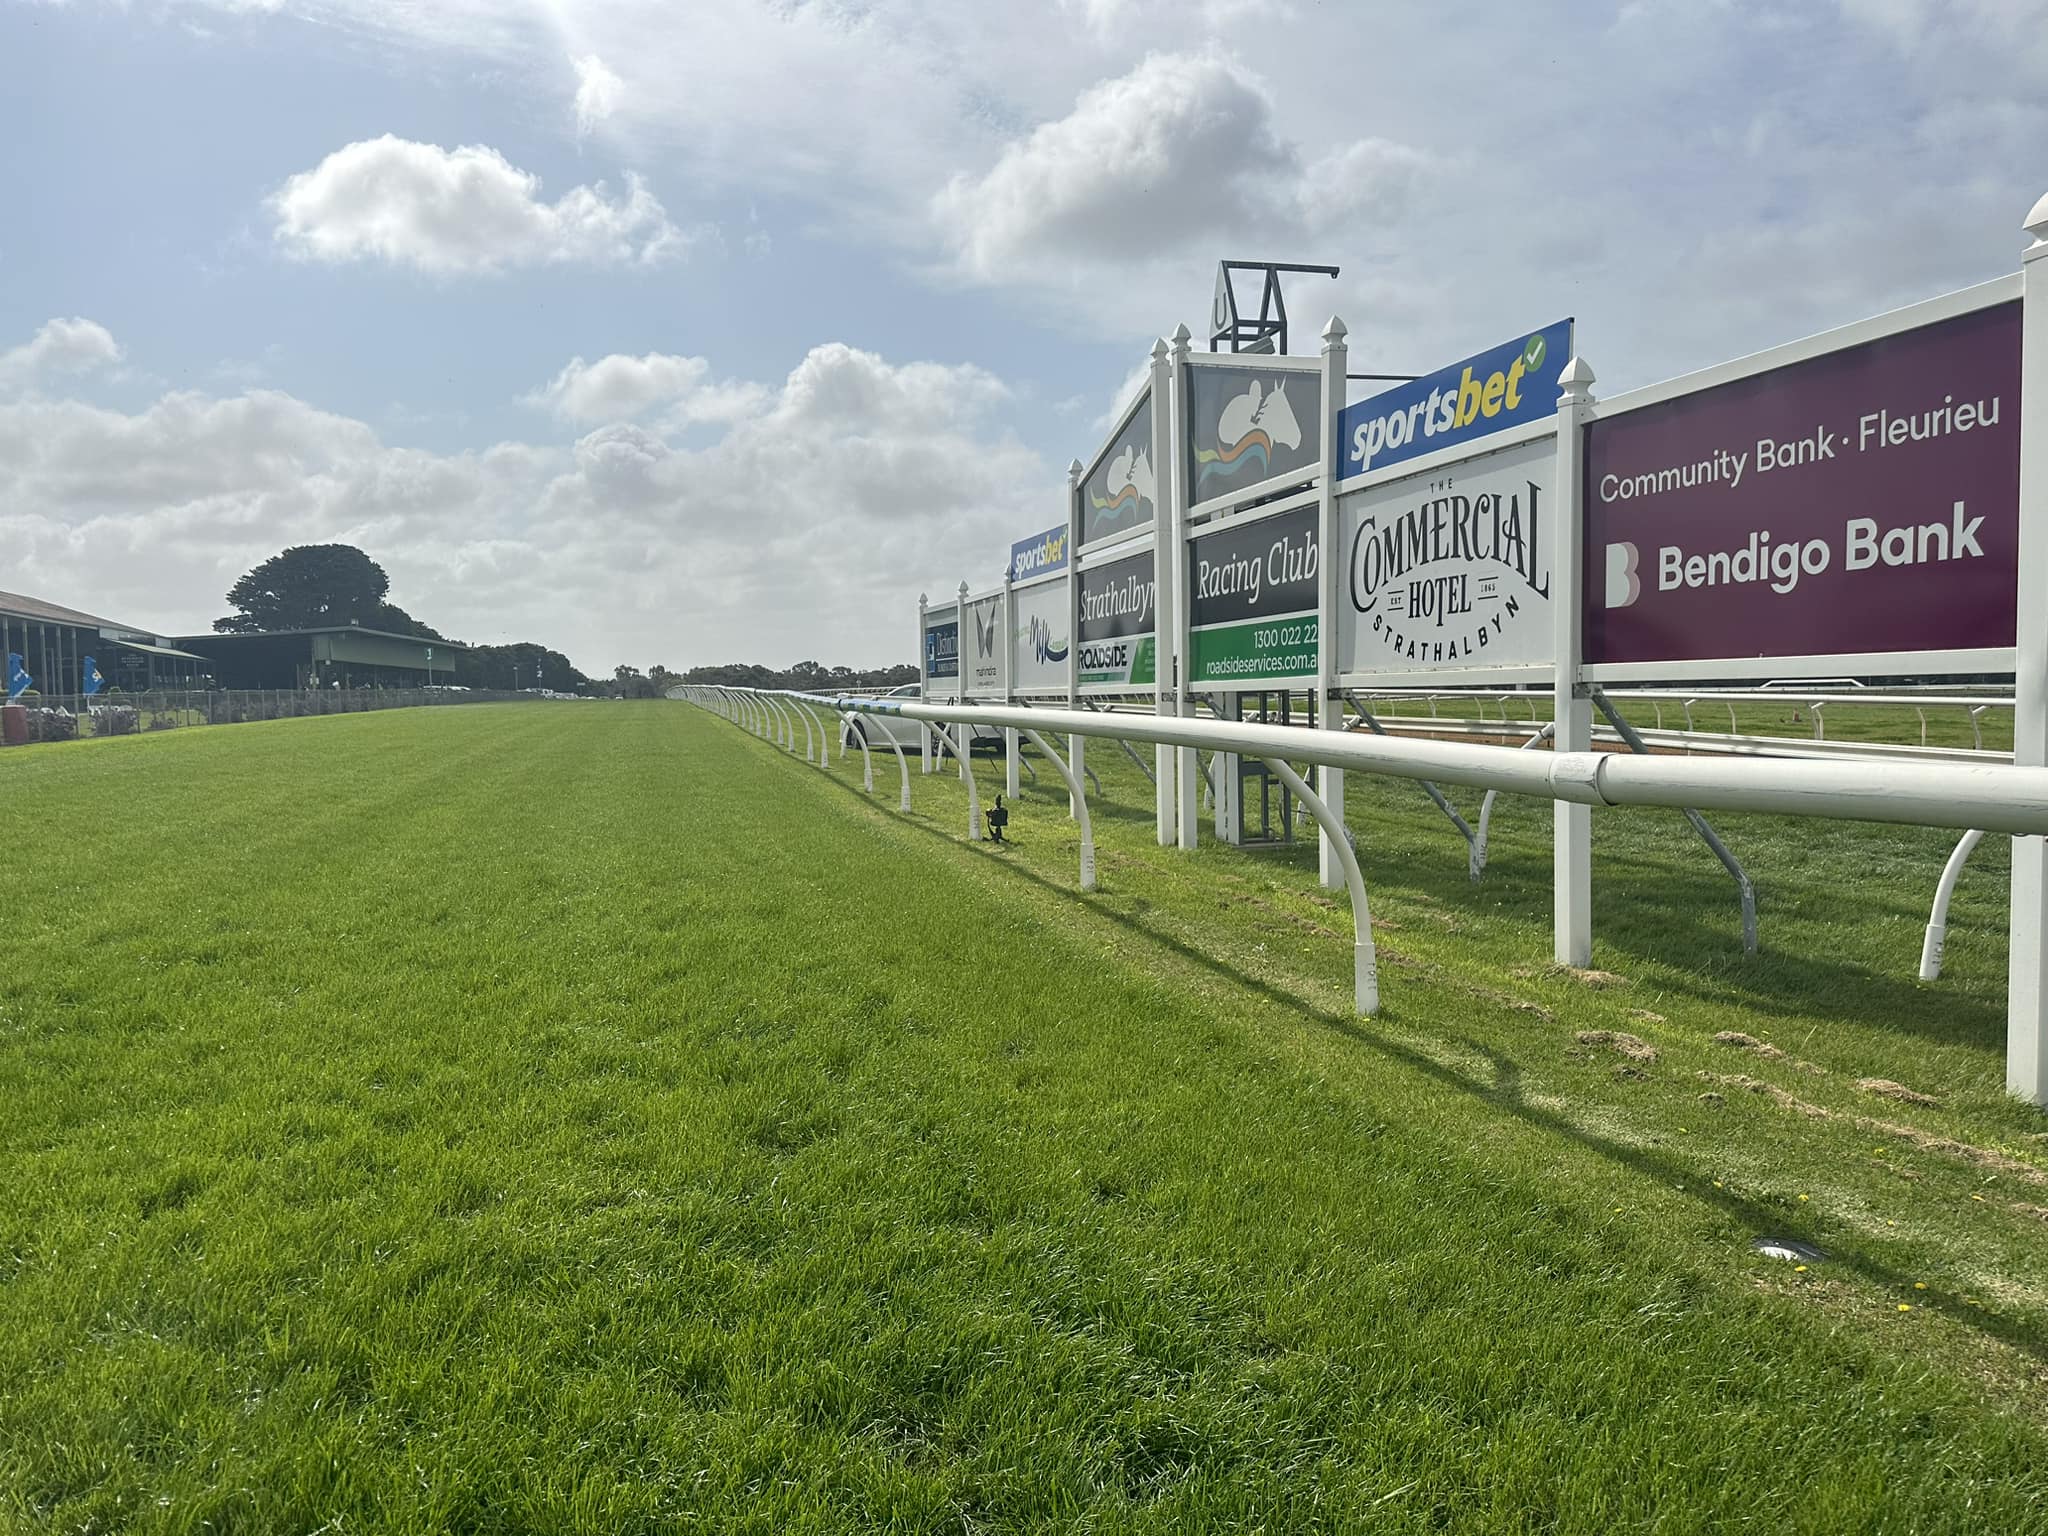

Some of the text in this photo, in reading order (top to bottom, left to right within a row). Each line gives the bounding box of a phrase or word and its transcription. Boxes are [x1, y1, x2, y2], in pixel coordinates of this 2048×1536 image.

[1351, 354, 1526, 472] sportsbet
[1599, 395, 2000, 503] Community Bank Fleurieu
[1430, 478, 1453, 494] THE
[1015, 535, 1063, 579] sportsbet
[1197, 530, 1317, 604] Racing Club
[1349, 480, 1550, 613] COMMERCIAL
[1658, 501, 1986, 594] Bendigo Bank
[1373, 595, 1520, 661] STRATHALBYN
[1408, 574, 1471, 627] HOTEL
[1078, 645, 1127, 670] ROADSIDE
[1206, 652, 1319, 676] roadsideservices.com.a
[1254, 624, 1319, 649] 1300 022 22
